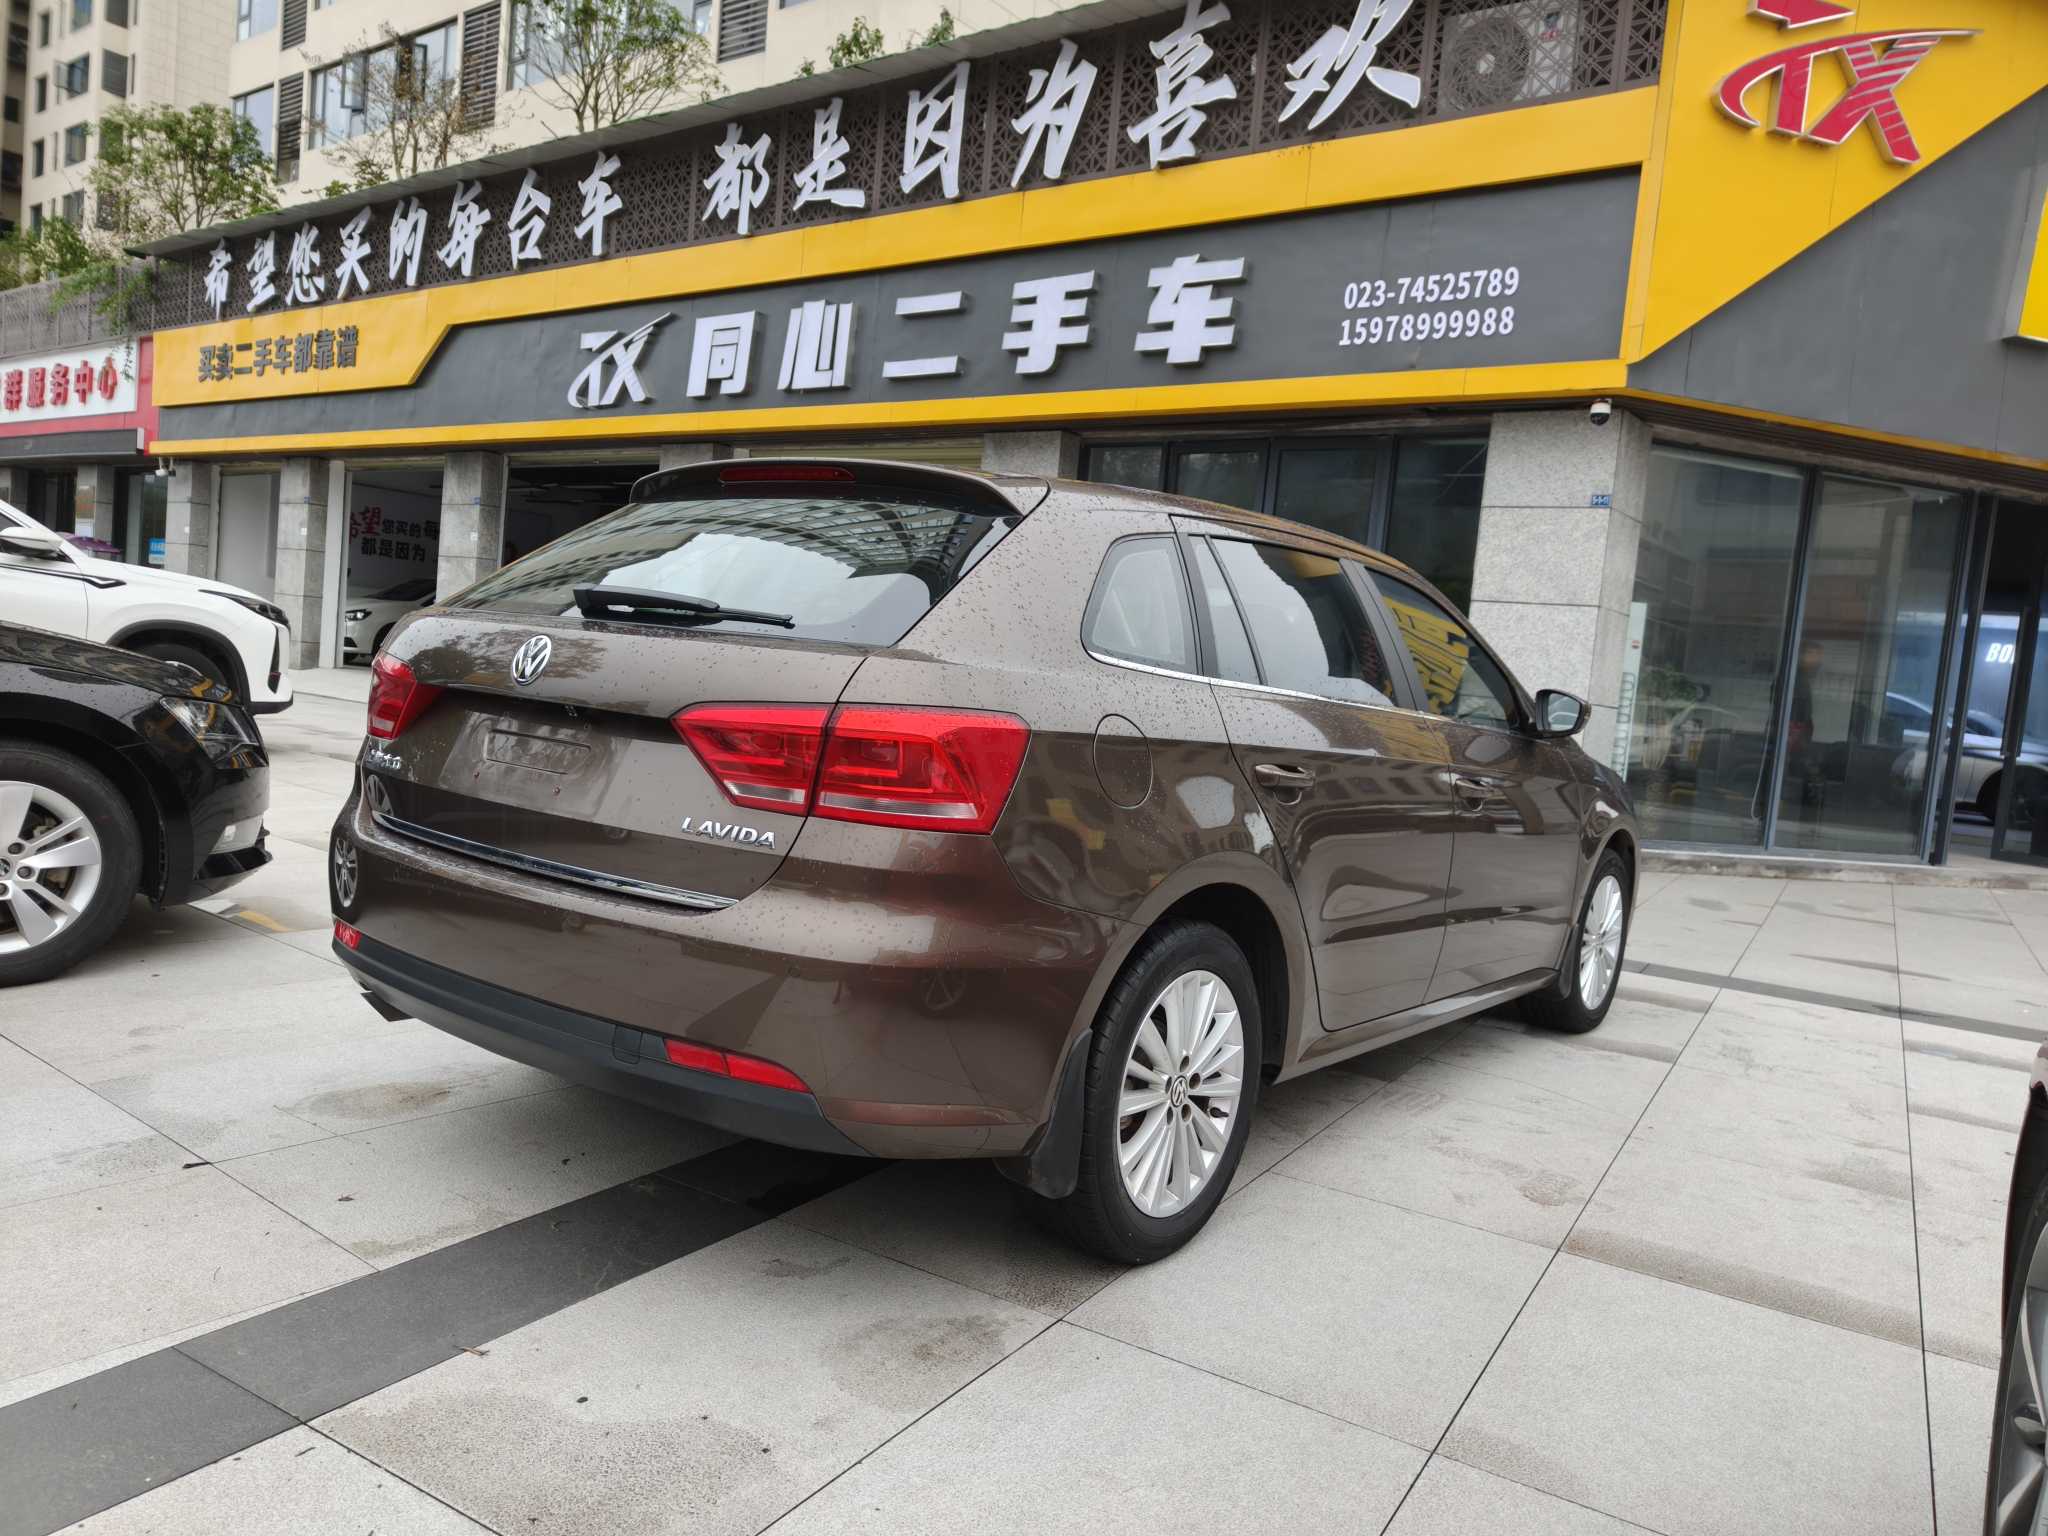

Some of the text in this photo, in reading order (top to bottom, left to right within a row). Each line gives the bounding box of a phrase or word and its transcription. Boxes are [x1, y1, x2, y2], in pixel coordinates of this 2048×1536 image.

[203, 0, 1421, 321] 希望您买的每台车 都是因为喜欢
[1343, 266, 1519, 310] 023-74525789
[686, 253, 1246, 398] 同心二手车
[1338, 306, 1515, 346] 15978999988
[198, 324, 359, 382] 买卖二手车都靠谱
[680, 816, 777, 849] LAVIDA
